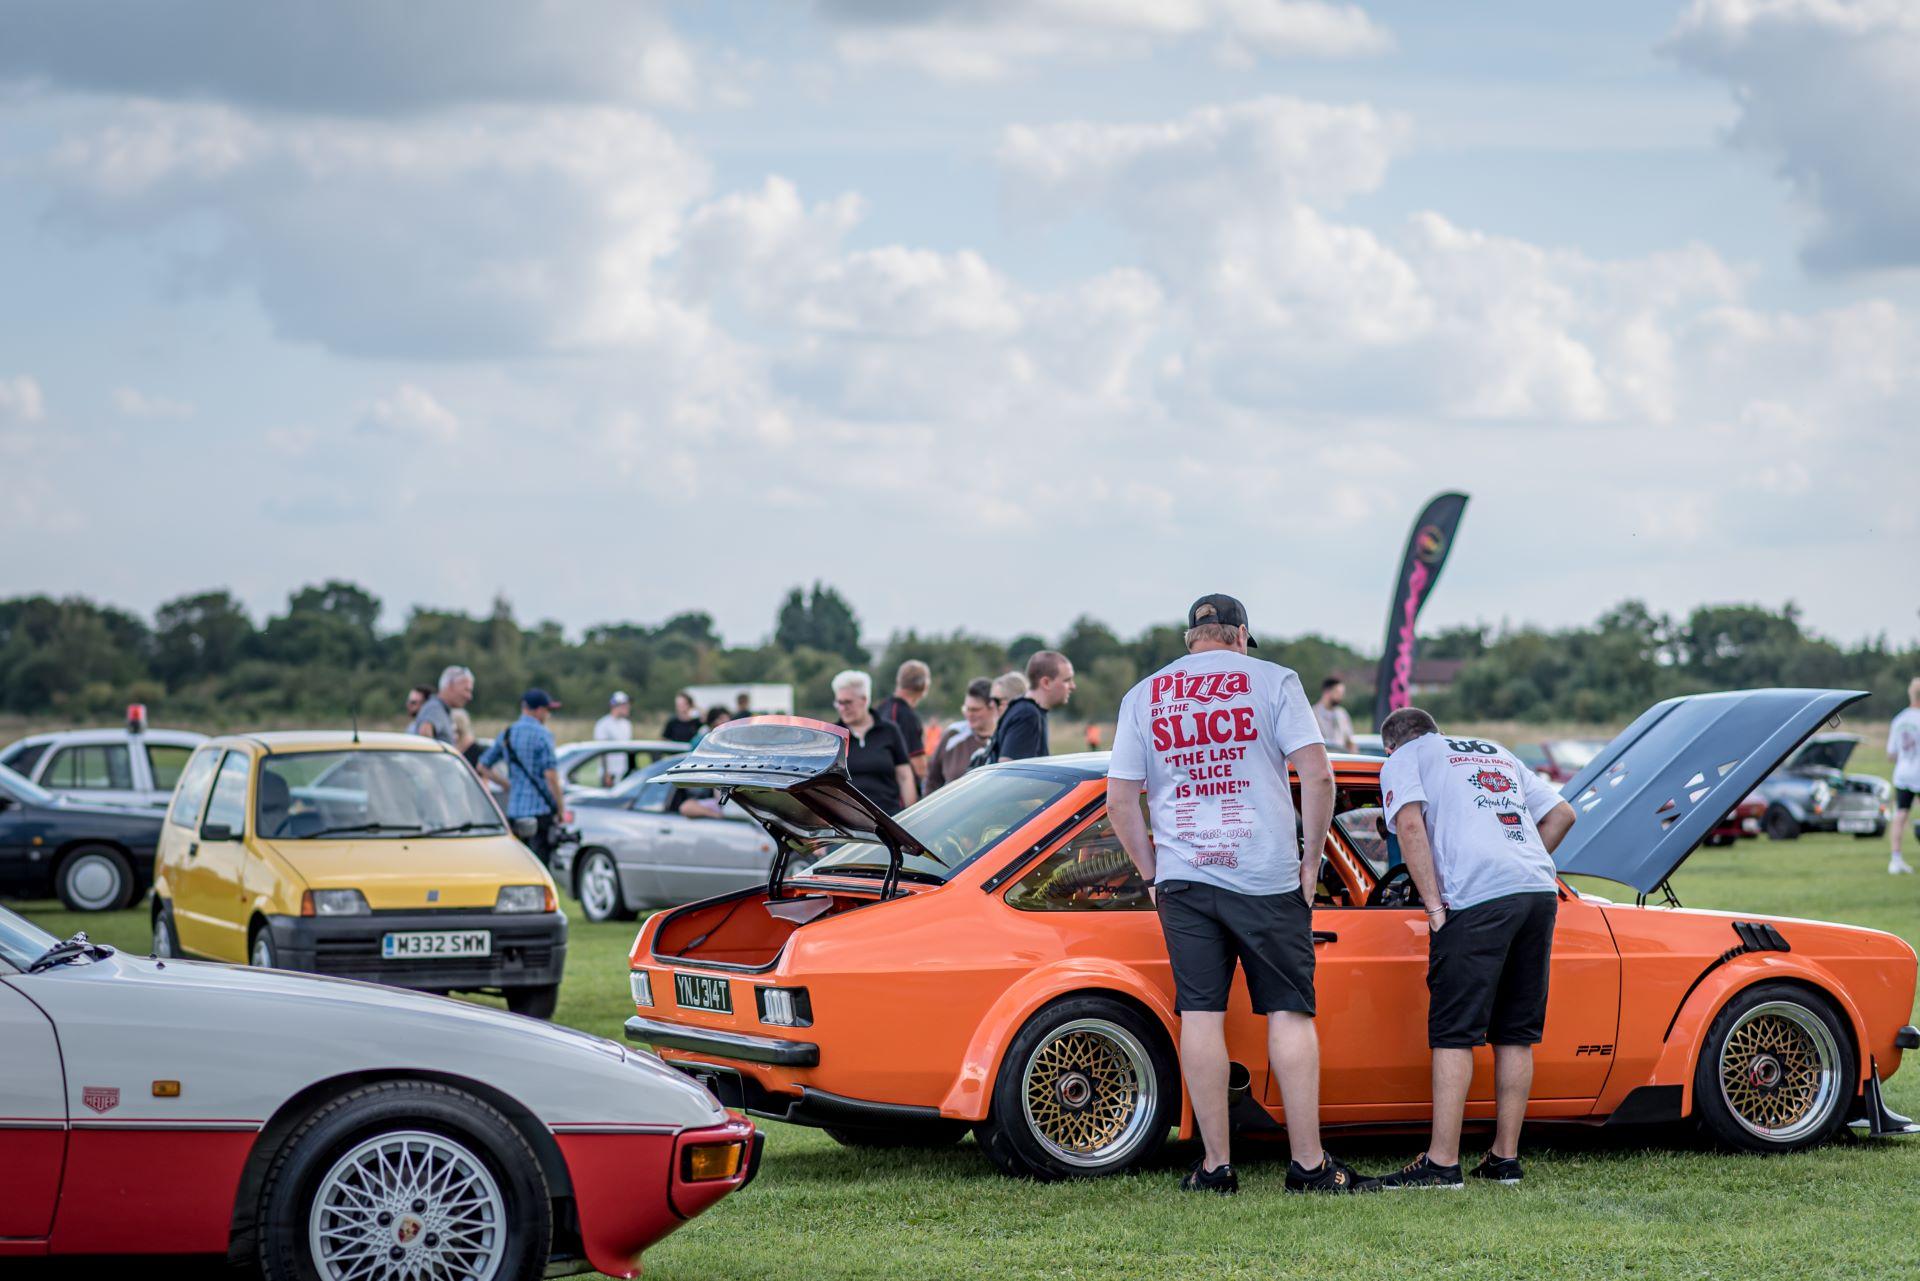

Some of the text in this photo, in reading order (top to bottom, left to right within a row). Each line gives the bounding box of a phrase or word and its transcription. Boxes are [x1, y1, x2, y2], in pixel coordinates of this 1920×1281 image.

[1150, 671, 1251, 704] Pizza
[1151, 703, 1189, 717] BY THE
[1152, 707, 1257, 752] SLICE
[1210, 747, 1246, 761] LAST
[1189, 764, 1232, 780] SLICE
[1176, 785, 1191, 799] IS
[677, 975, 727, 1009] YNJ 314T
[85, 1096, 118, 1110] HEUER
